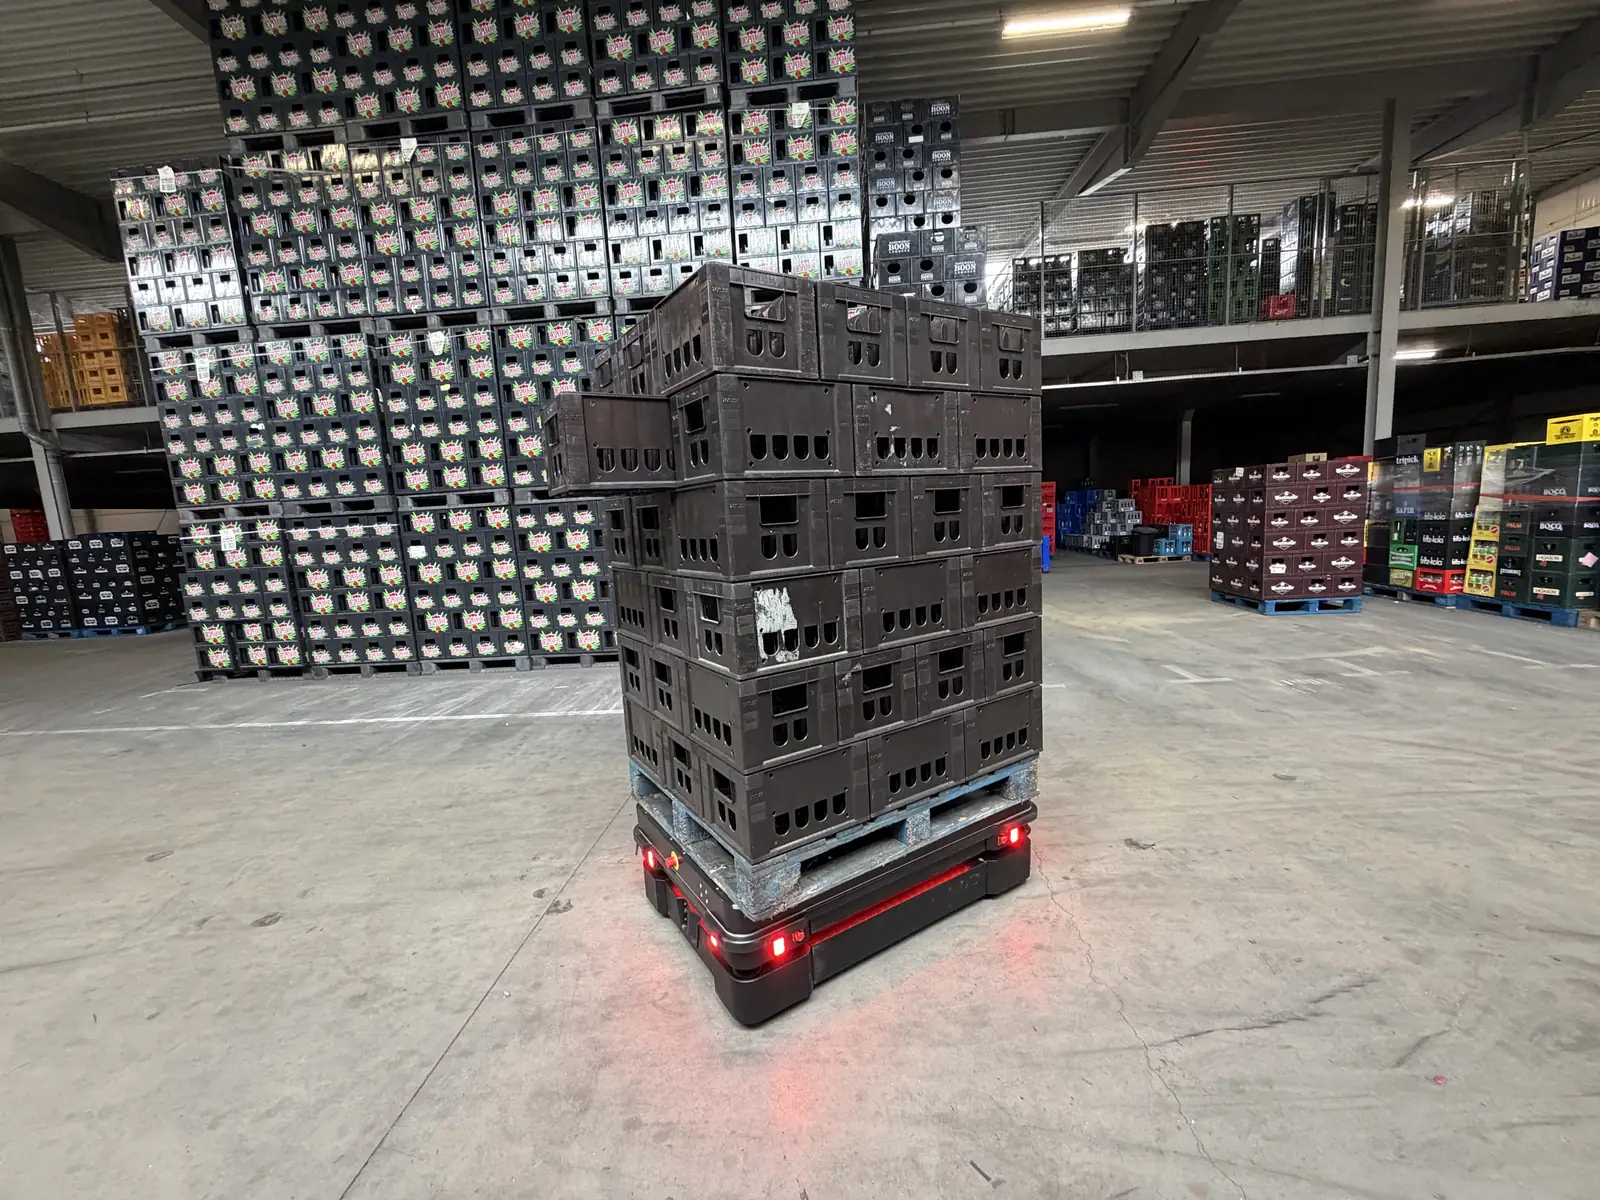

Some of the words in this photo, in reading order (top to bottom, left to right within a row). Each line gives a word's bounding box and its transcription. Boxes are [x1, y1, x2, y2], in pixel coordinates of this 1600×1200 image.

[931, 105, 950, 113] BOON
[932, 152, 951, 160] BOON
[888, 242, 911, 251] BOON
[954, 262, 976, 271] BOON
[1396, 455, 1419, 465] tripick
